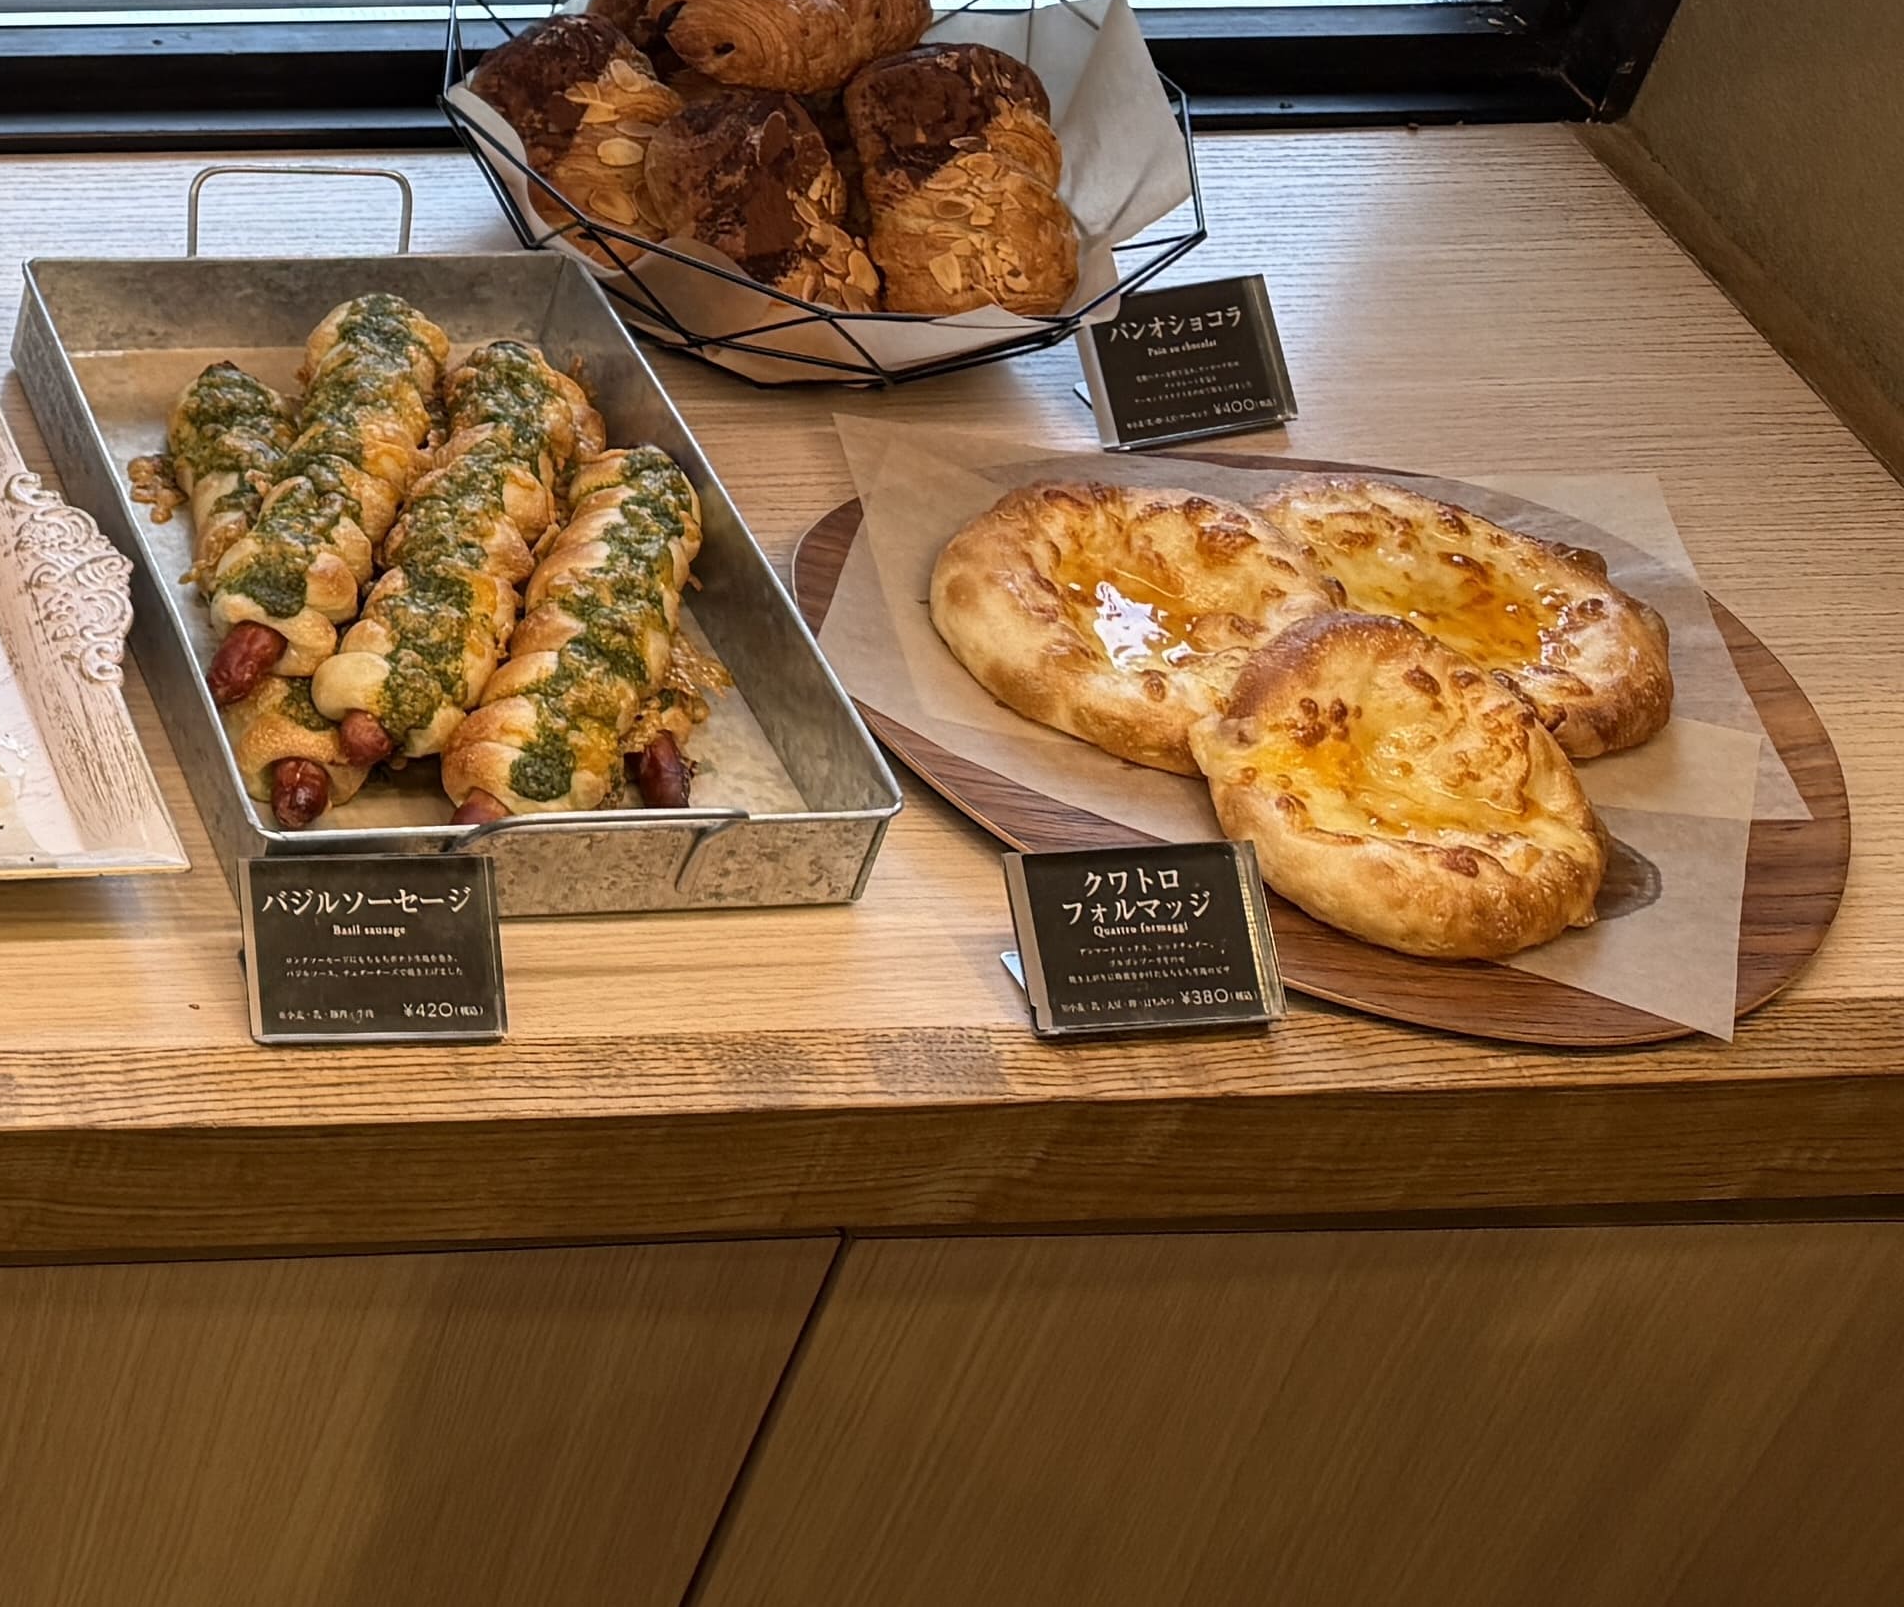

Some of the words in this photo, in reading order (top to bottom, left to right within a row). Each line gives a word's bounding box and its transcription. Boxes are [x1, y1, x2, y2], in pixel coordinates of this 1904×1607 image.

[1147, 346, 1167, 358] Pain
[1084, 867, 1180, 898] クワトロ
[261, 885, 472, 916] バジルソーセージ
[1061, 890, 1211, 926] フォルマッジ
[333, 924, 361, 936] Basil
[364, 925, 406, 938] sausage
[1093, 923, 1137, 939] Quattro
[1140, 920, 1189, 935] formaggi
